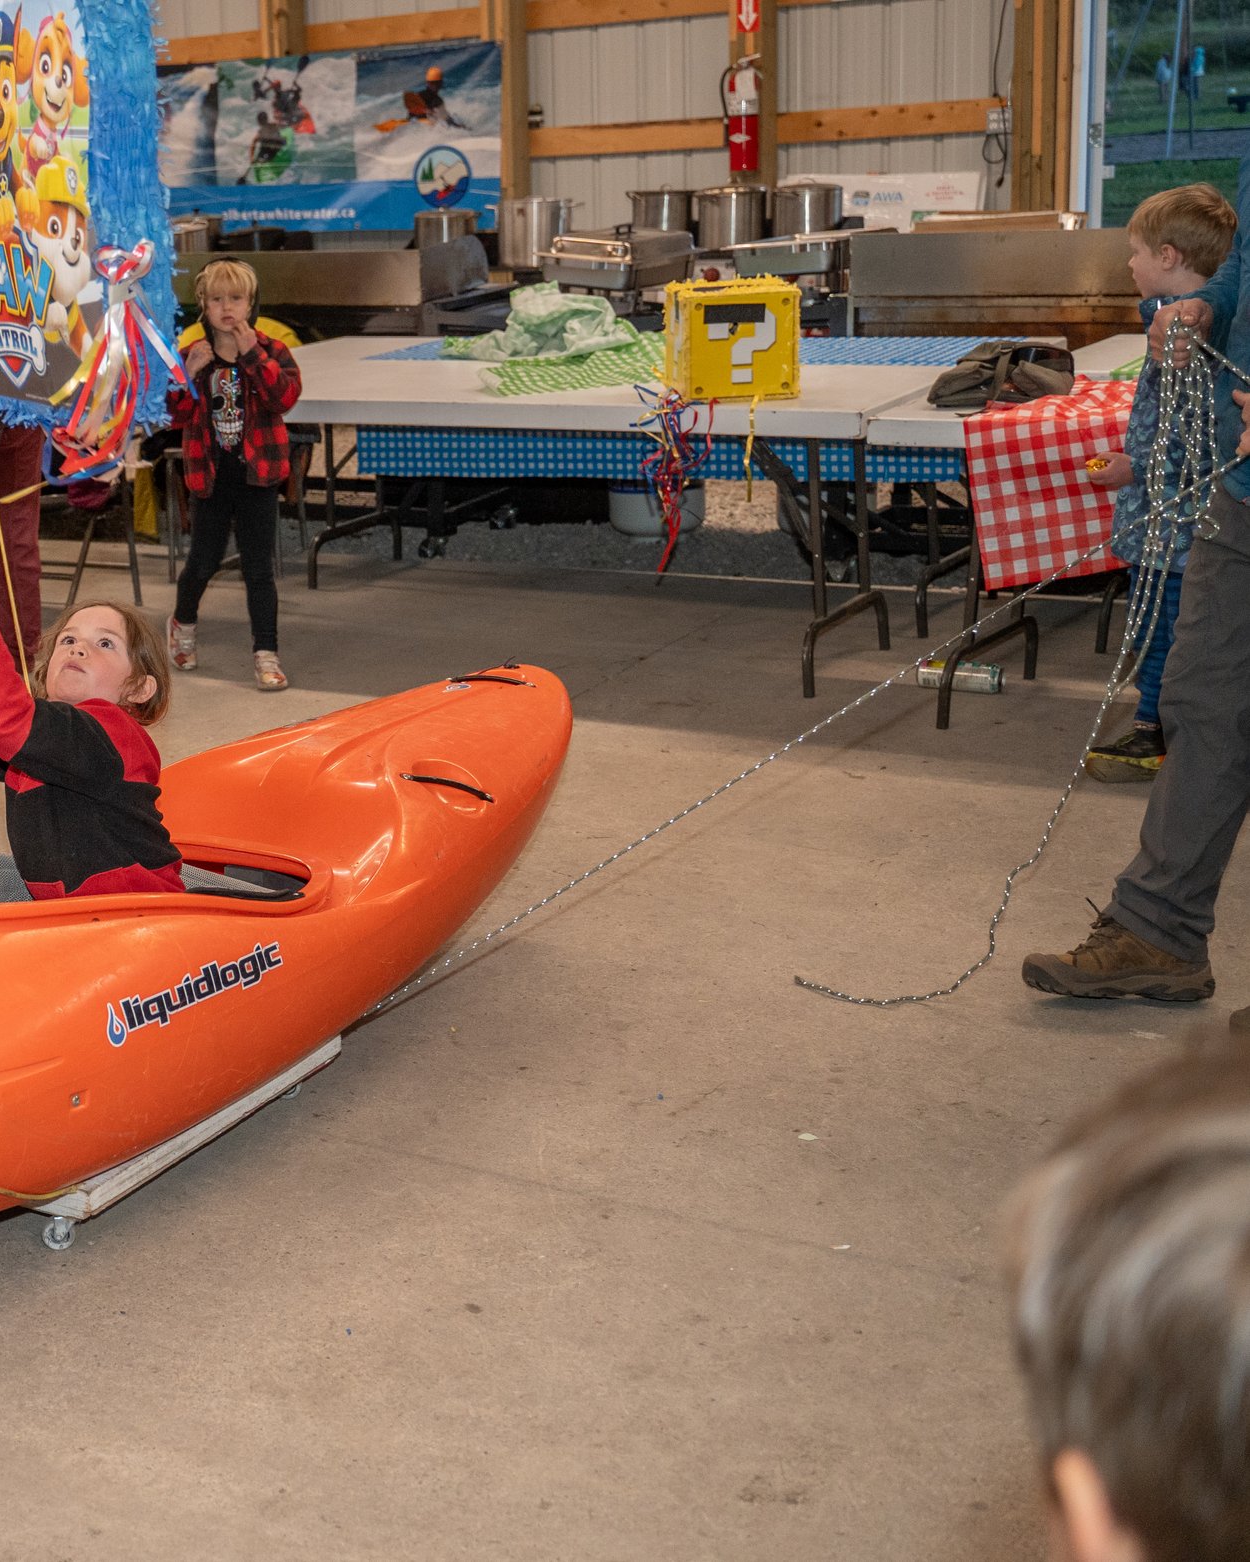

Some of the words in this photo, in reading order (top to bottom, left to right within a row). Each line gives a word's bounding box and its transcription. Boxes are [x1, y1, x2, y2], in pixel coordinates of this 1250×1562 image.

[873, 191, 904, 203] AWA
[221, 208, 356, 221] albertawhitewater.ca
[120, 941, 283, 1032] liquidlogic
